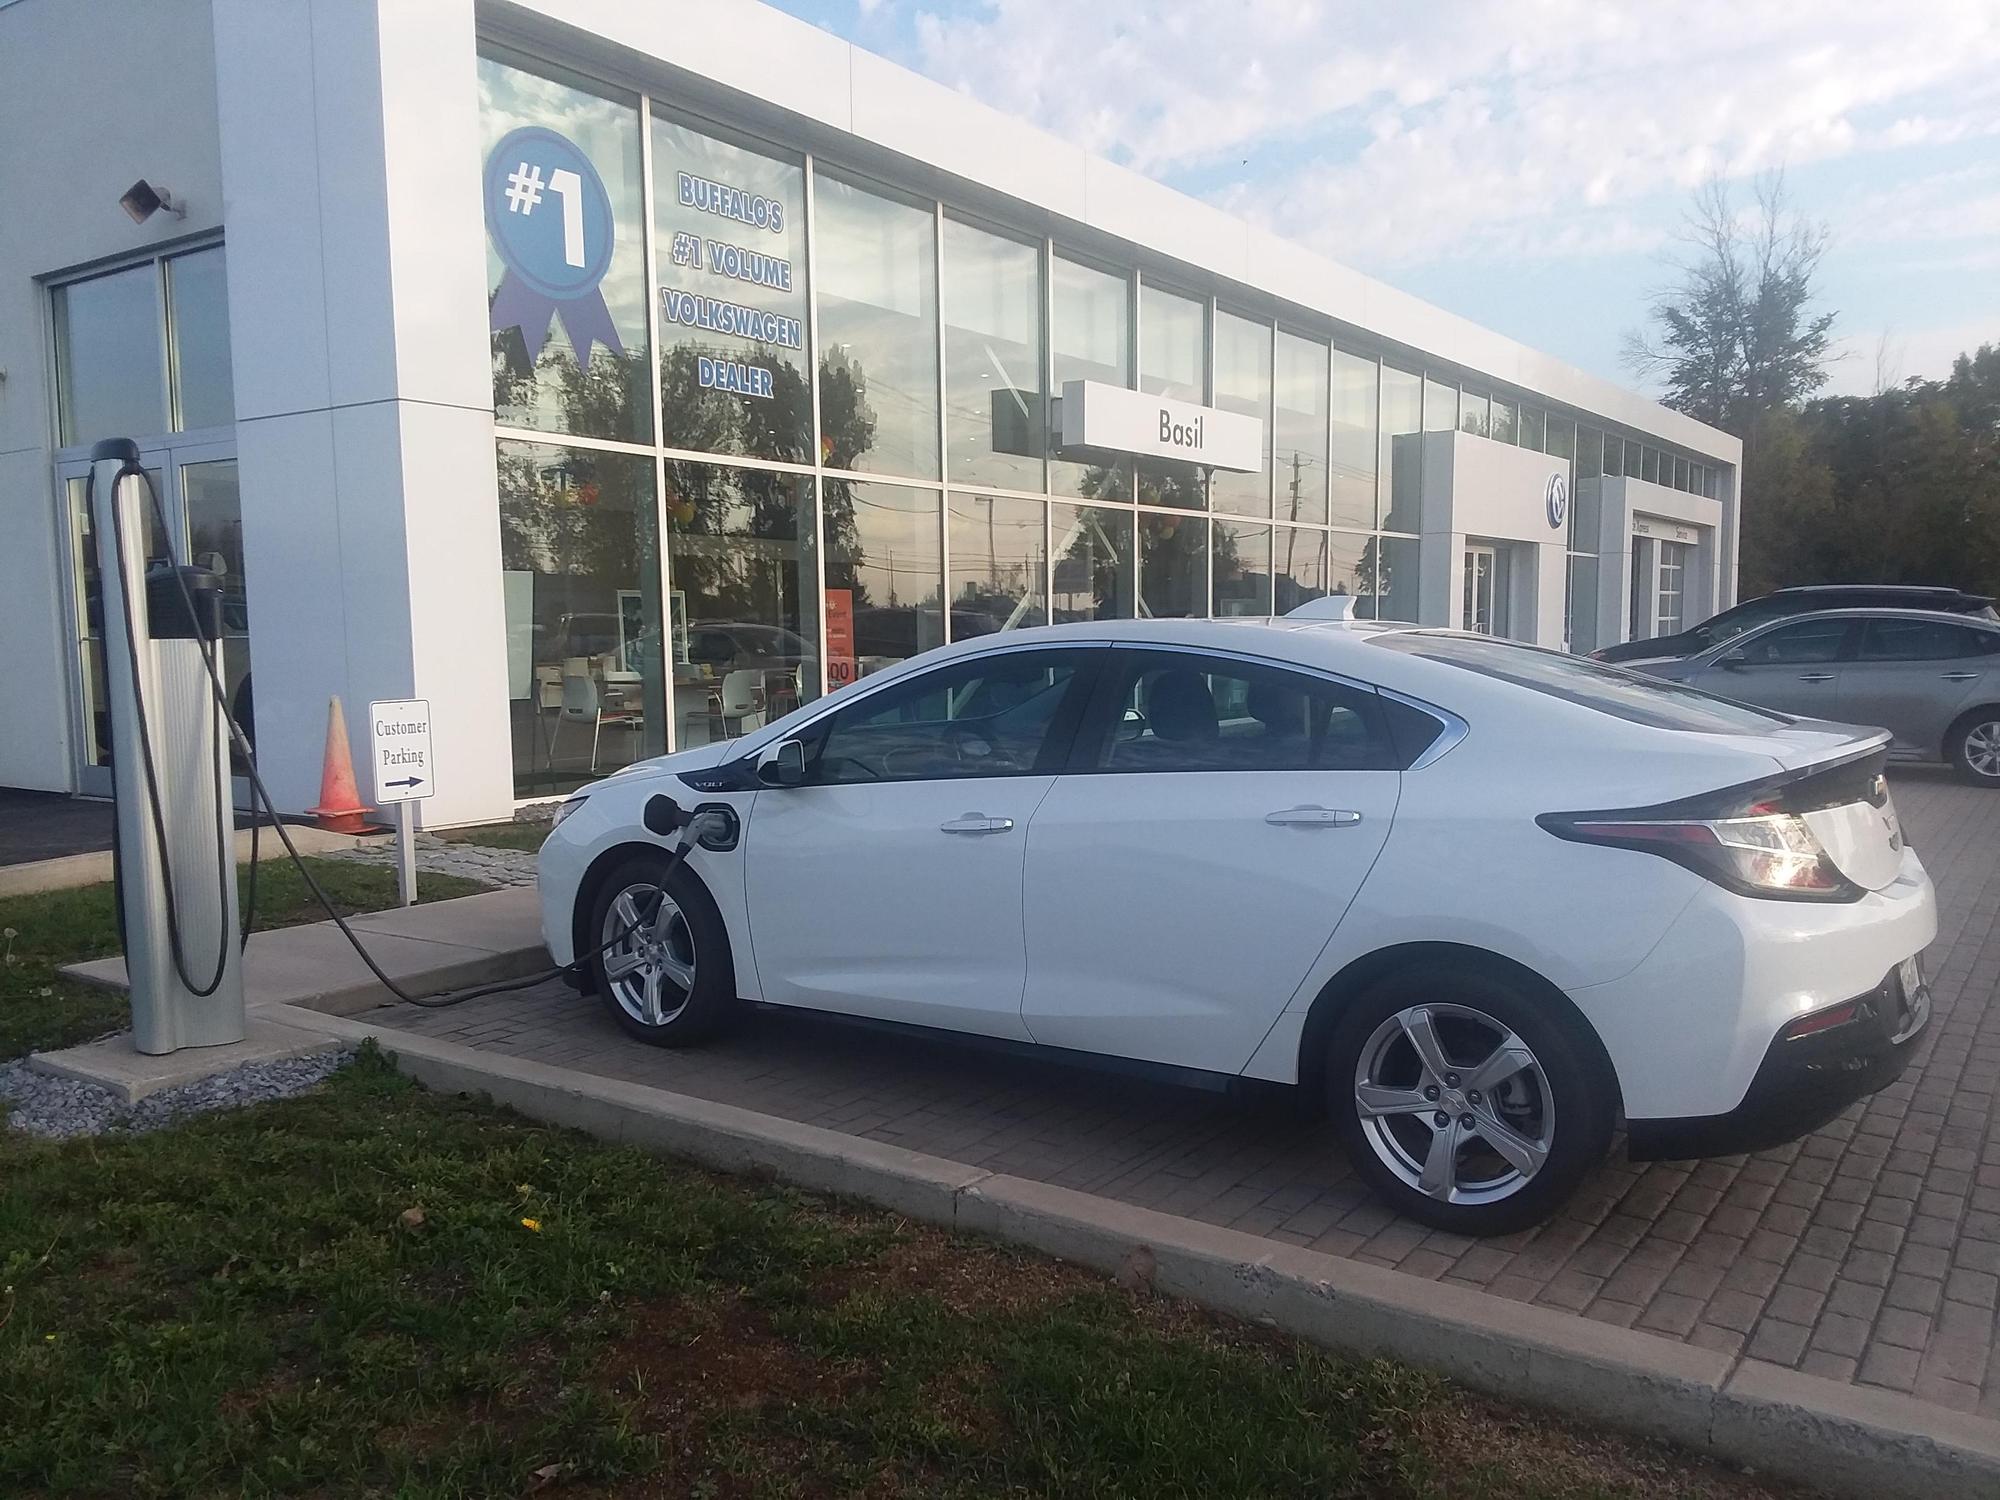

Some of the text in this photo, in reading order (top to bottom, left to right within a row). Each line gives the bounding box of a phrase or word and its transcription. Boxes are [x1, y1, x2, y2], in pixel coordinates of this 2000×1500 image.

[504, 161, 585, 269] #1
[677, 171, 784, 233] BUFFALO'S
[672, 231, 792, 292] #1 VOLUME
[661, 287, 802, 349] VOLKSWAGEN
[698, 356, 773, 399] DEALER
[1159, 409, 1203, 449] Basil
[376, 720, 427, 737] Customer
[383, 747, 425, 768] Parking
